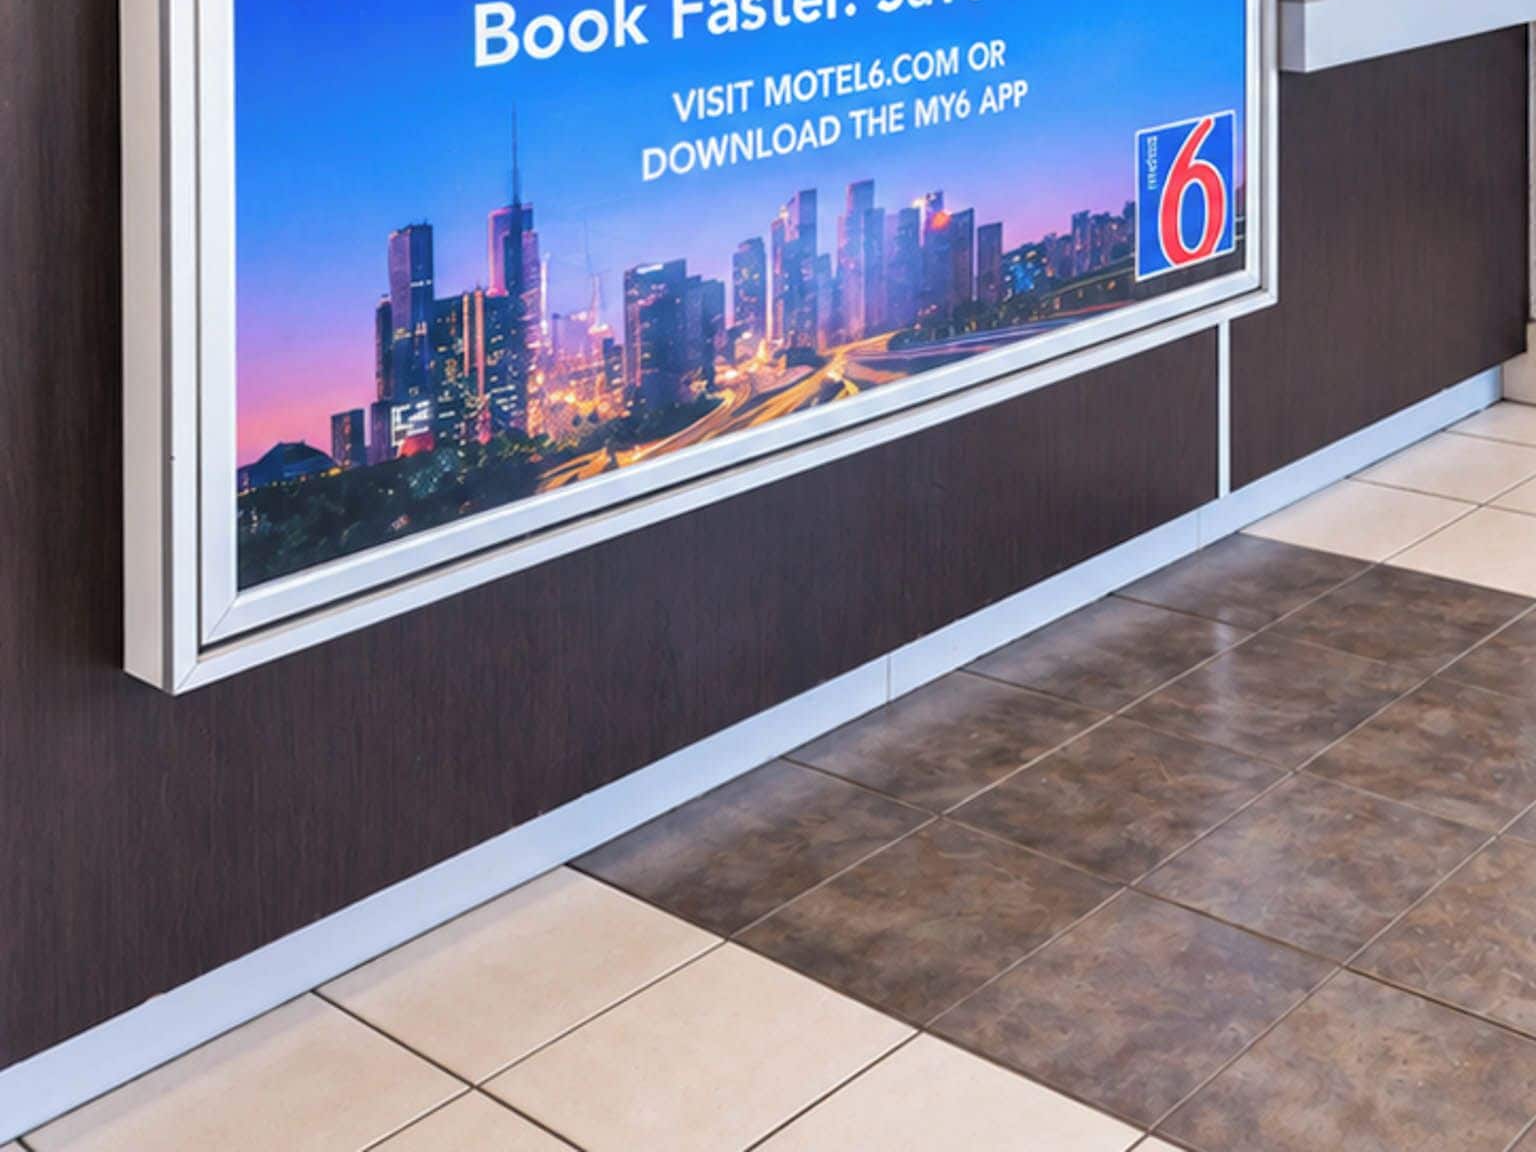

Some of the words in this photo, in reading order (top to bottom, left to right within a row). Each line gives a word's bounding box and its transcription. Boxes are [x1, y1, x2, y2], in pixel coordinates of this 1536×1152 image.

[642, 115, 841, 181] DOWNLOAD
[848, 102, 905, 140] THE
[915, 89, 971, 128] MY6
[979, 79, 1029, 115] APP
[672, 80, 754, 123] VISIT
[764, 46, 960, 107] MOTEL6.COM
[967, 39, 1007, 71] OR
[1158, 116, 1227, 267] 6
